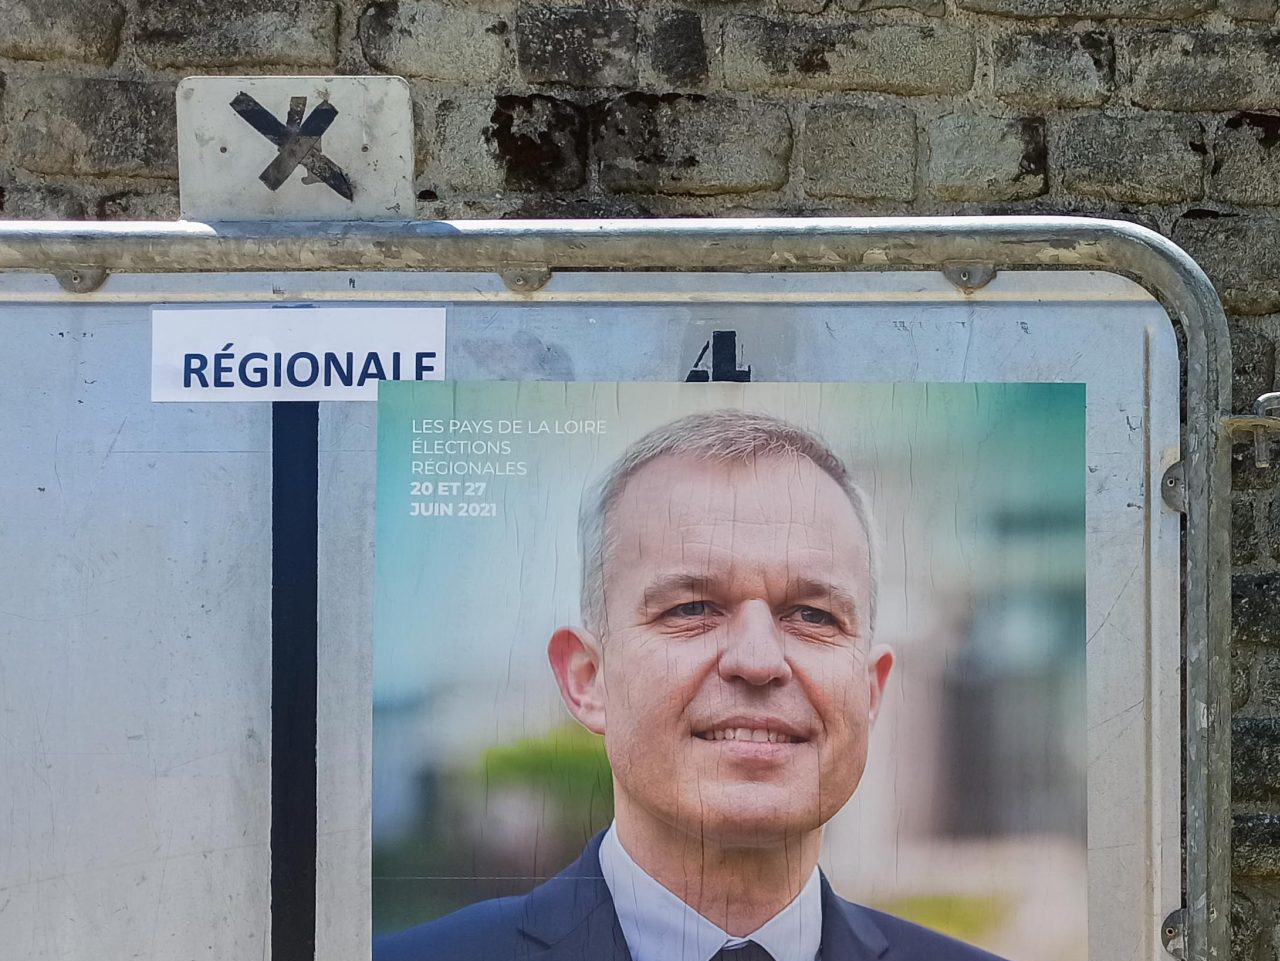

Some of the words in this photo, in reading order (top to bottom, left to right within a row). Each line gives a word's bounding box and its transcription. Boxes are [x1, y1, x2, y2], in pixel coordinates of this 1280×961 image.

[412, 420, 444, 434] LES
[450, 420, 496, 434] PAYS
[500, 420, 524, 434] DE
[529, 420, 551, 434] LA
[556, 420, 606, 434] LOIRE
[412, 437, 511, 455] ÉLECTIONS
[412, 458, 527, 476] RÉGIONALES
[410, 482, 434, 496] 20
[438, 482, 460, 496] ET
[464, 482, 486, 496] 27
[410, 503, 452, 516] JUIN
[458, 503, 497, 516] 2021
